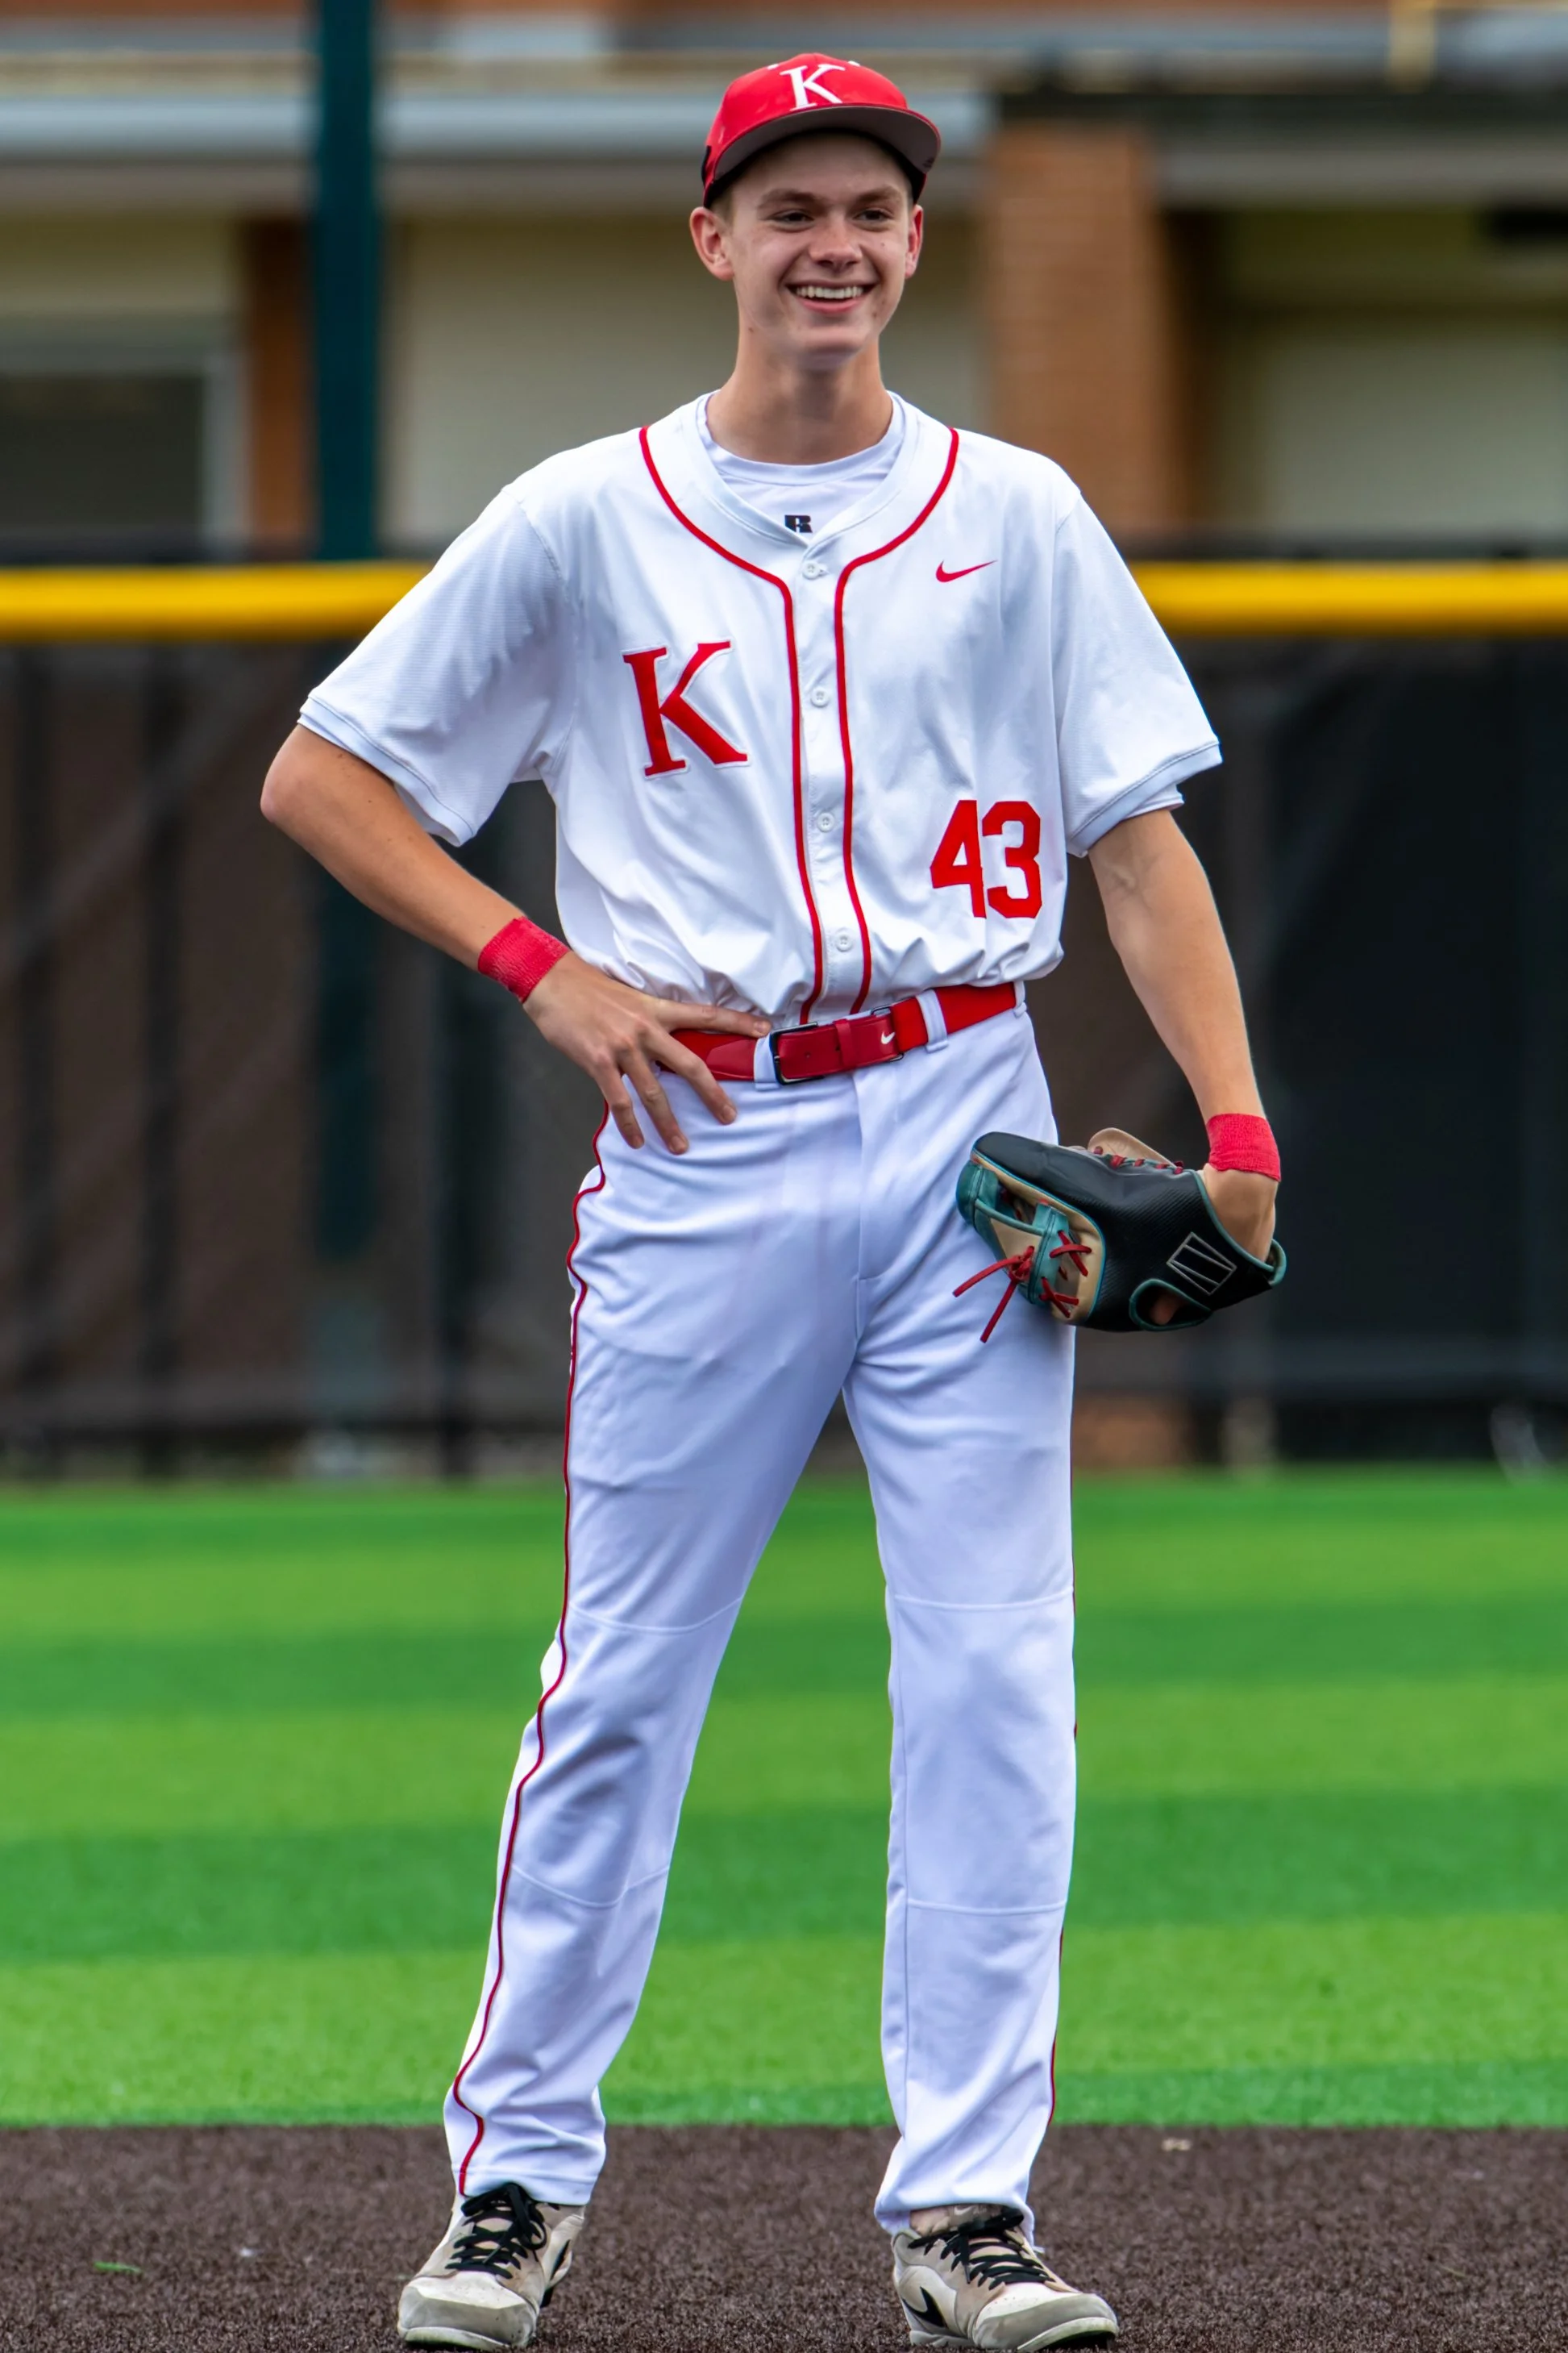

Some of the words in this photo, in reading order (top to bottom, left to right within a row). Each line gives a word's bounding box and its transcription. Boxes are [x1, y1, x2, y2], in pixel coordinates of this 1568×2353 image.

[780, 64, 845, 110] K
[784, 514, 813, 533] R
[622, 640, 748, 777] K
[930, 799, 1042, 919] 43
